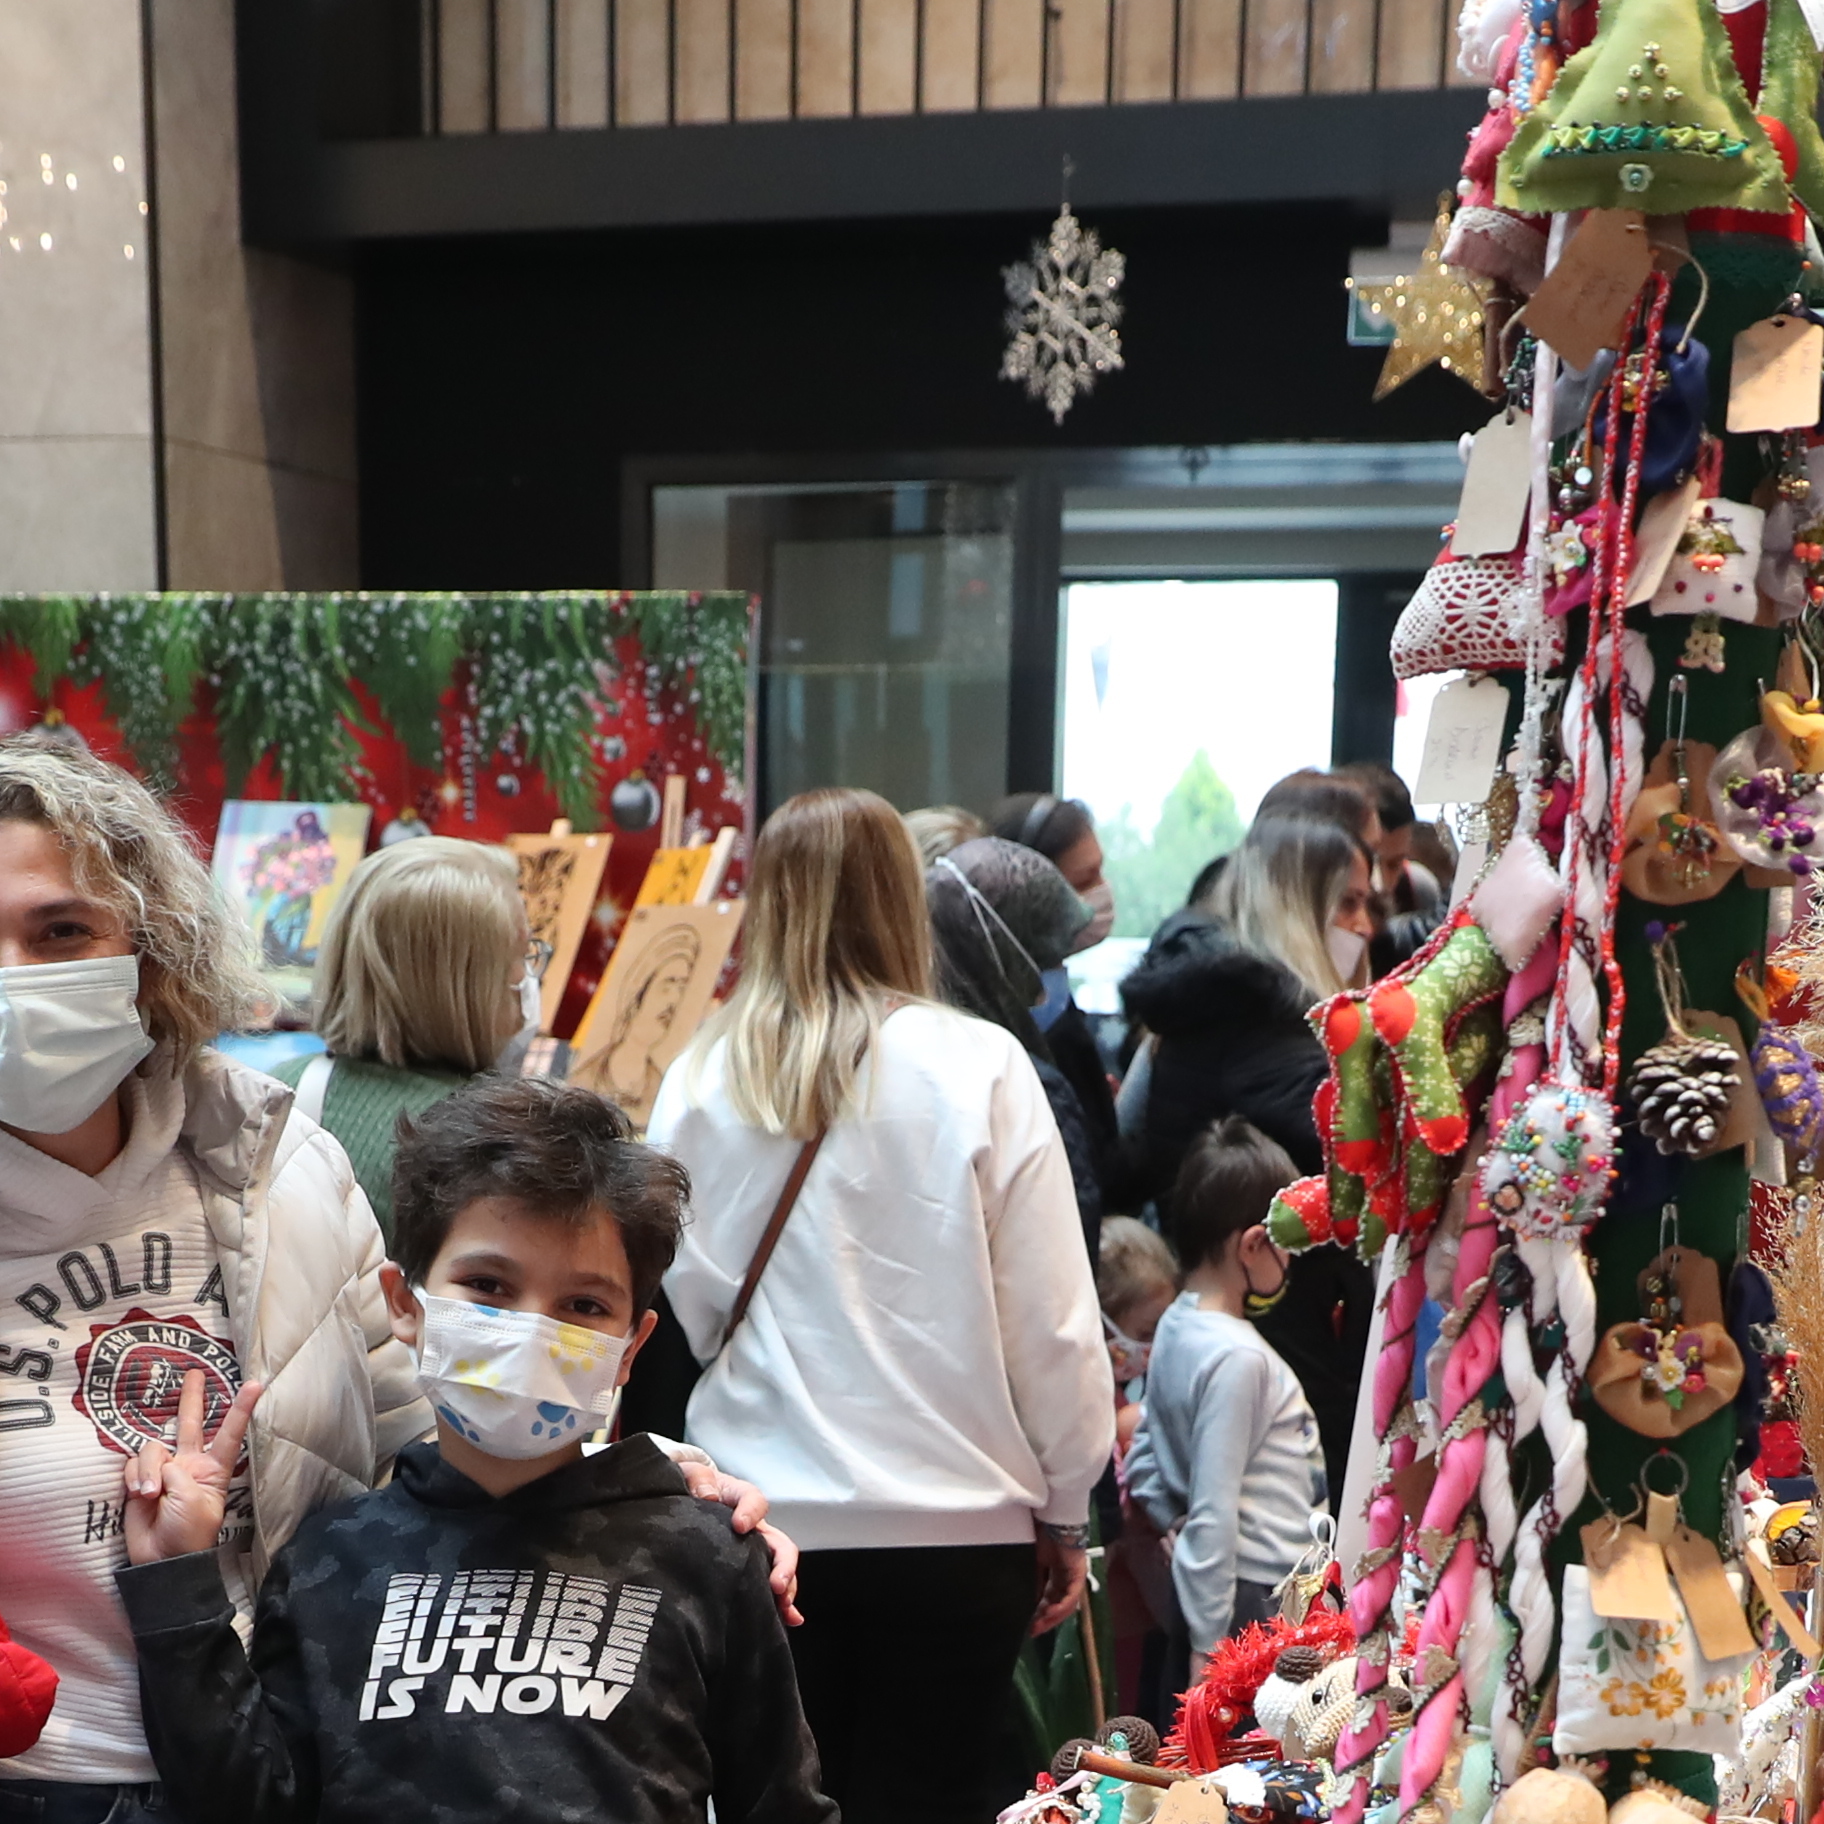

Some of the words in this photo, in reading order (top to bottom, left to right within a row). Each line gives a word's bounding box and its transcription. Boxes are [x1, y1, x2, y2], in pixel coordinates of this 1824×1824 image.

[15, 1232, 174, 1331] POLO
[98, 1329, 139, 1366] FARM
[147, 1327, 191, 1349] AND
[368, 1637, 642, 1687] FUTURE
[358, 1676, 426, 1721] IS
[444, 1674, 632, 1721] NOW
